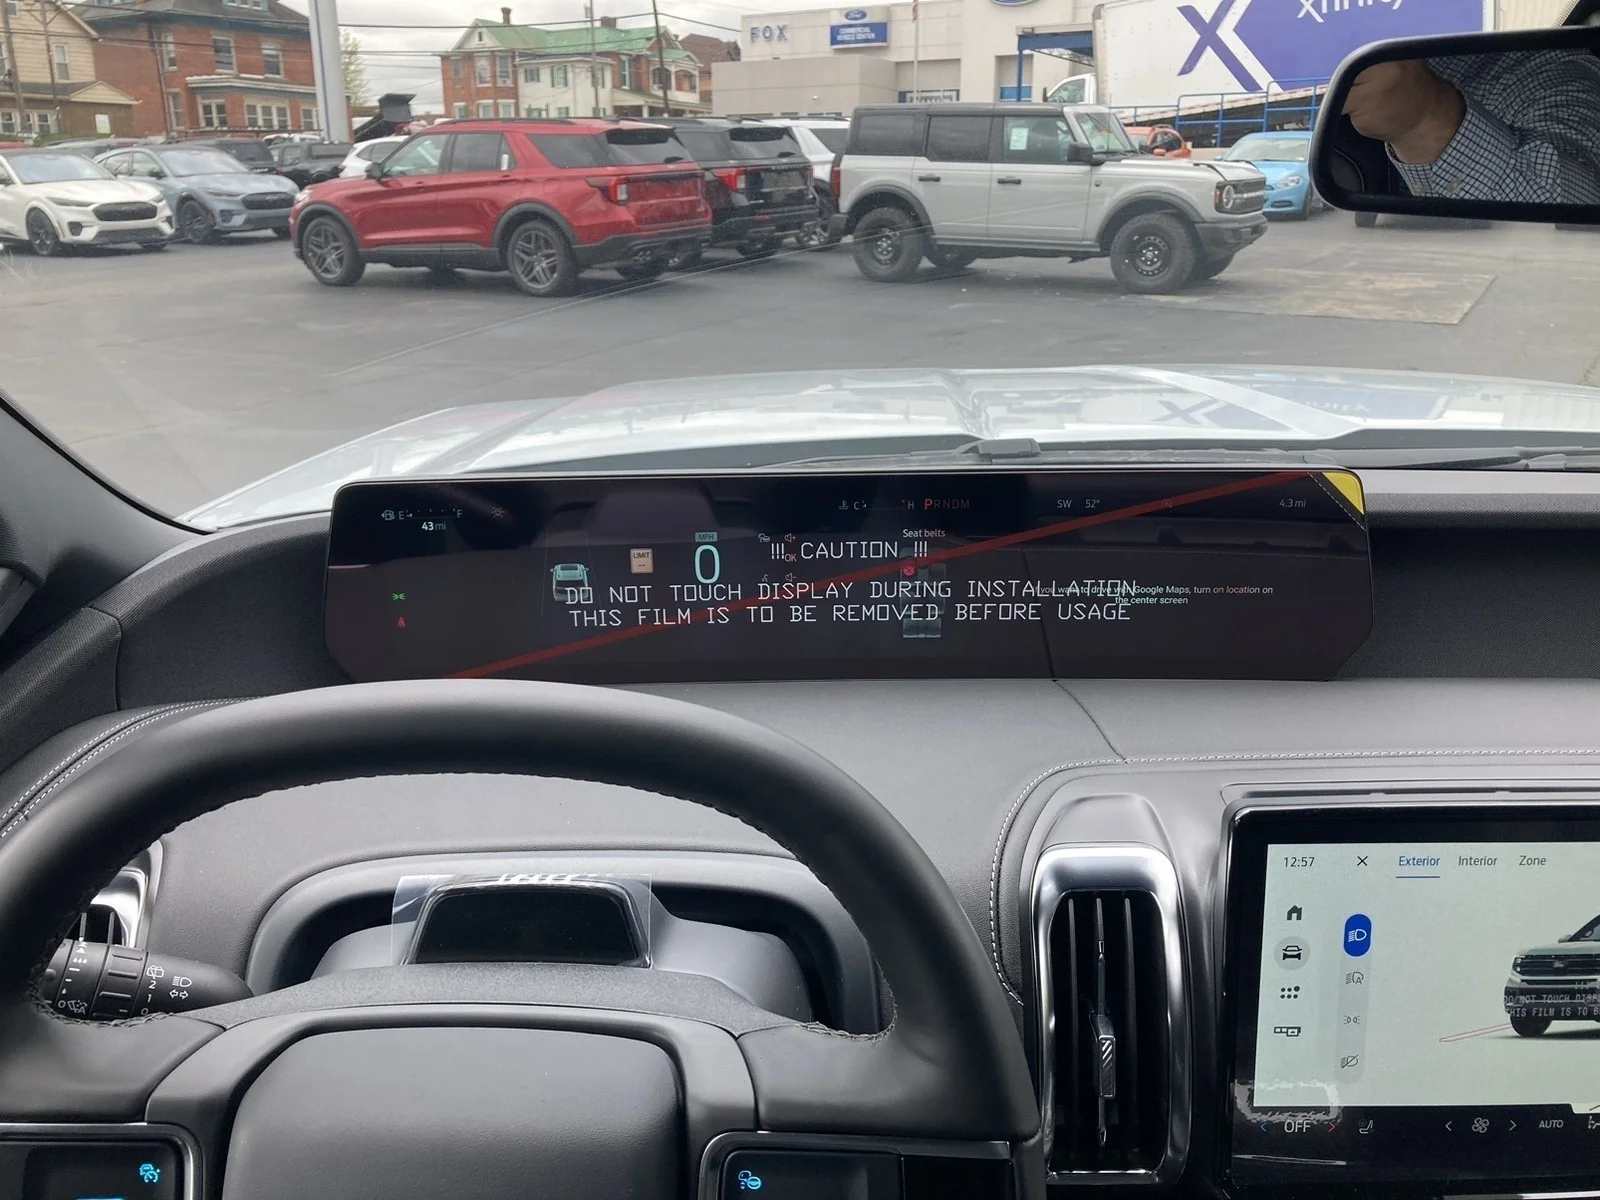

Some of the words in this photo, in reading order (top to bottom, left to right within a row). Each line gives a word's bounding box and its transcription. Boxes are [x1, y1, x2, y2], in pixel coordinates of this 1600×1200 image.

[750, 24, 788, 43] FOX
[1056, 499, 1072, 508] SW
[1279, 498, 1294, 508] 4.3
[1294, 498, 1307, 508] mi
[421, 521, 435, 531] 43
[435, 521, 447, 530] mi
[698, 533, 715, 541] MPH
[902, 529, 923, 538] Seat
[924, 529, 946, 538] belts
[800, 541, 898, 560] CAUTION
[784, 553, 797, 563] OK
[694, 544, 720, 584] 0
[565, 587, 593, 605] DO
[609, 585, 652, 603] NOT
[669, 583, 741, 602] TOUCH
[757, 581, 853, 600] DISPLAY
[869, 580, 951, 598] DURING
[967, 580, 1136, 597] INSTALLATION
[1134, 585, 1164, 595] Google
[1165, 585, 1192, 595] Maps,
[1193, 586, 1211, 594] turn
[1226, 585, 1260, 594] location
[1115, 596, 1128, 604] the
[1130, 596, 1158, 604] center
[569, 609, 622, 627] THIS
[638, 607, 691, 626] FILM
[707, 606, 730, 625] IS
[746, 605, 774, 623] TO
[790, 604, 817, 622] BE
[833, 603, 939, 621] REMOVED
[955, 603, 1041, 620] BEFORE
[1058, 603, 1131, 620] USAGE
[1283, 856, 1315, 868] 12:57
[1398, 855, 1440, 867] Exterior
[1458, 855, 1498, 867] Interior
[1518, 855, 1547, 867] Zone
[148, 980, 156, 989] 2
[1532, 1007, 1555, 1016] FILM
[1560, 1007, 1572, 1016] IS
[1577, 1006, 1588, 1016] TO
[1283, 1120, 1312, 1134] OFF
[1538, 1119, 1565, 1129] AUTO
